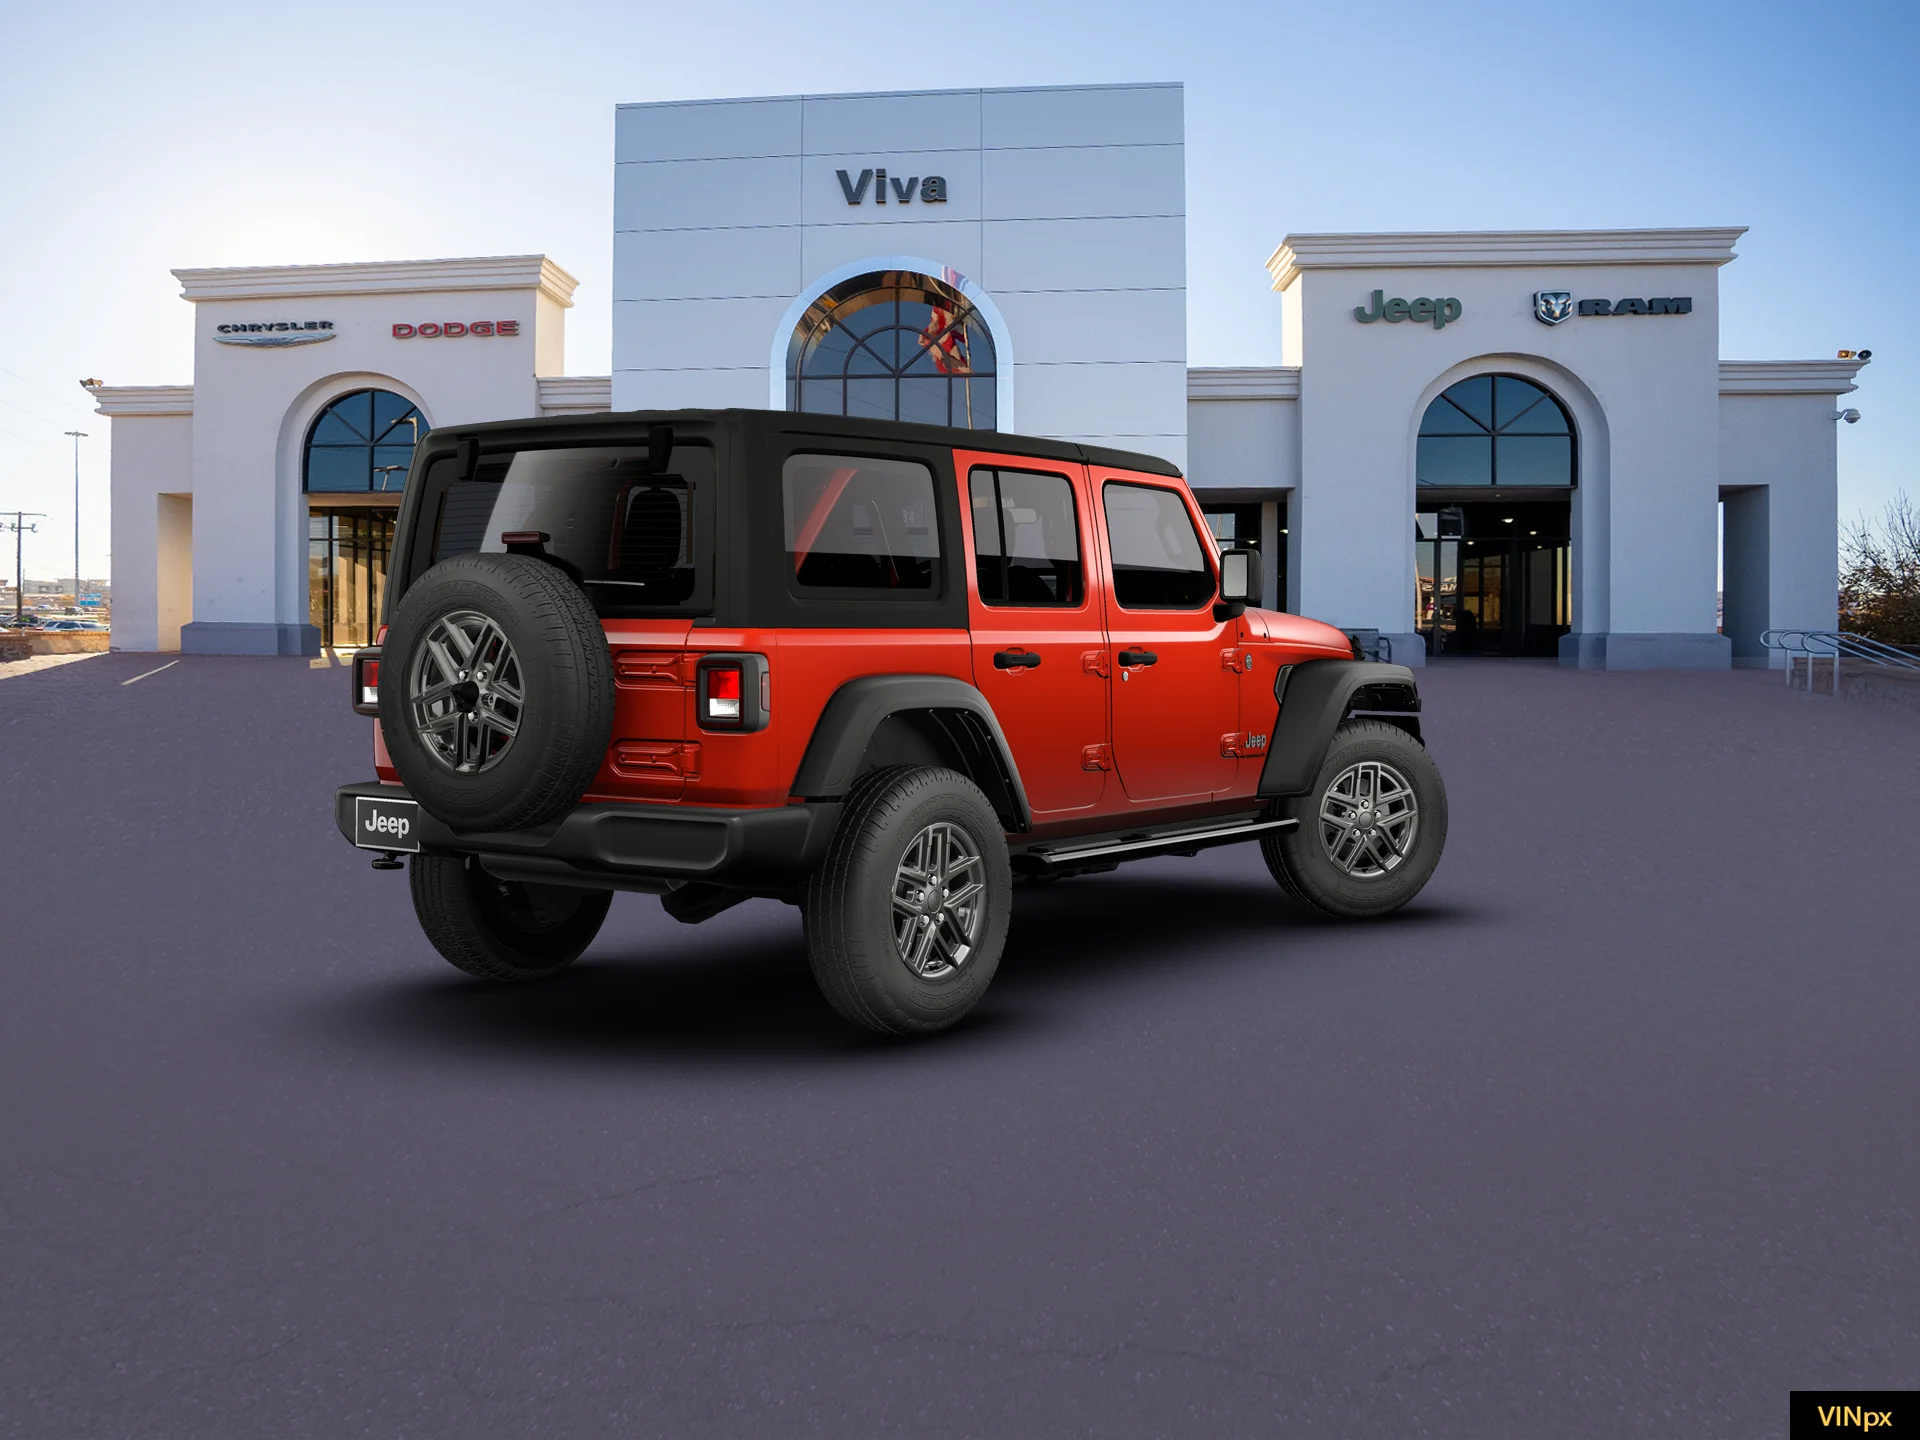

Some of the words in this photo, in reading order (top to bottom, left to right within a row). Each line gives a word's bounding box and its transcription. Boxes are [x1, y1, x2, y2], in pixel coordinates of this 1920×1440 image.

[835, 168, 947, 205] Viva
[1354, 289, 1462, 329] Jeep
[1578, 297, 1692, 316] RAM
[217, 320, 334, 334] CHRYSLER
[392, 320, 520, 338] DODGE
[1244, 731, 1267, 750] Jeep
[365, 809, 410, 839] Jeep
